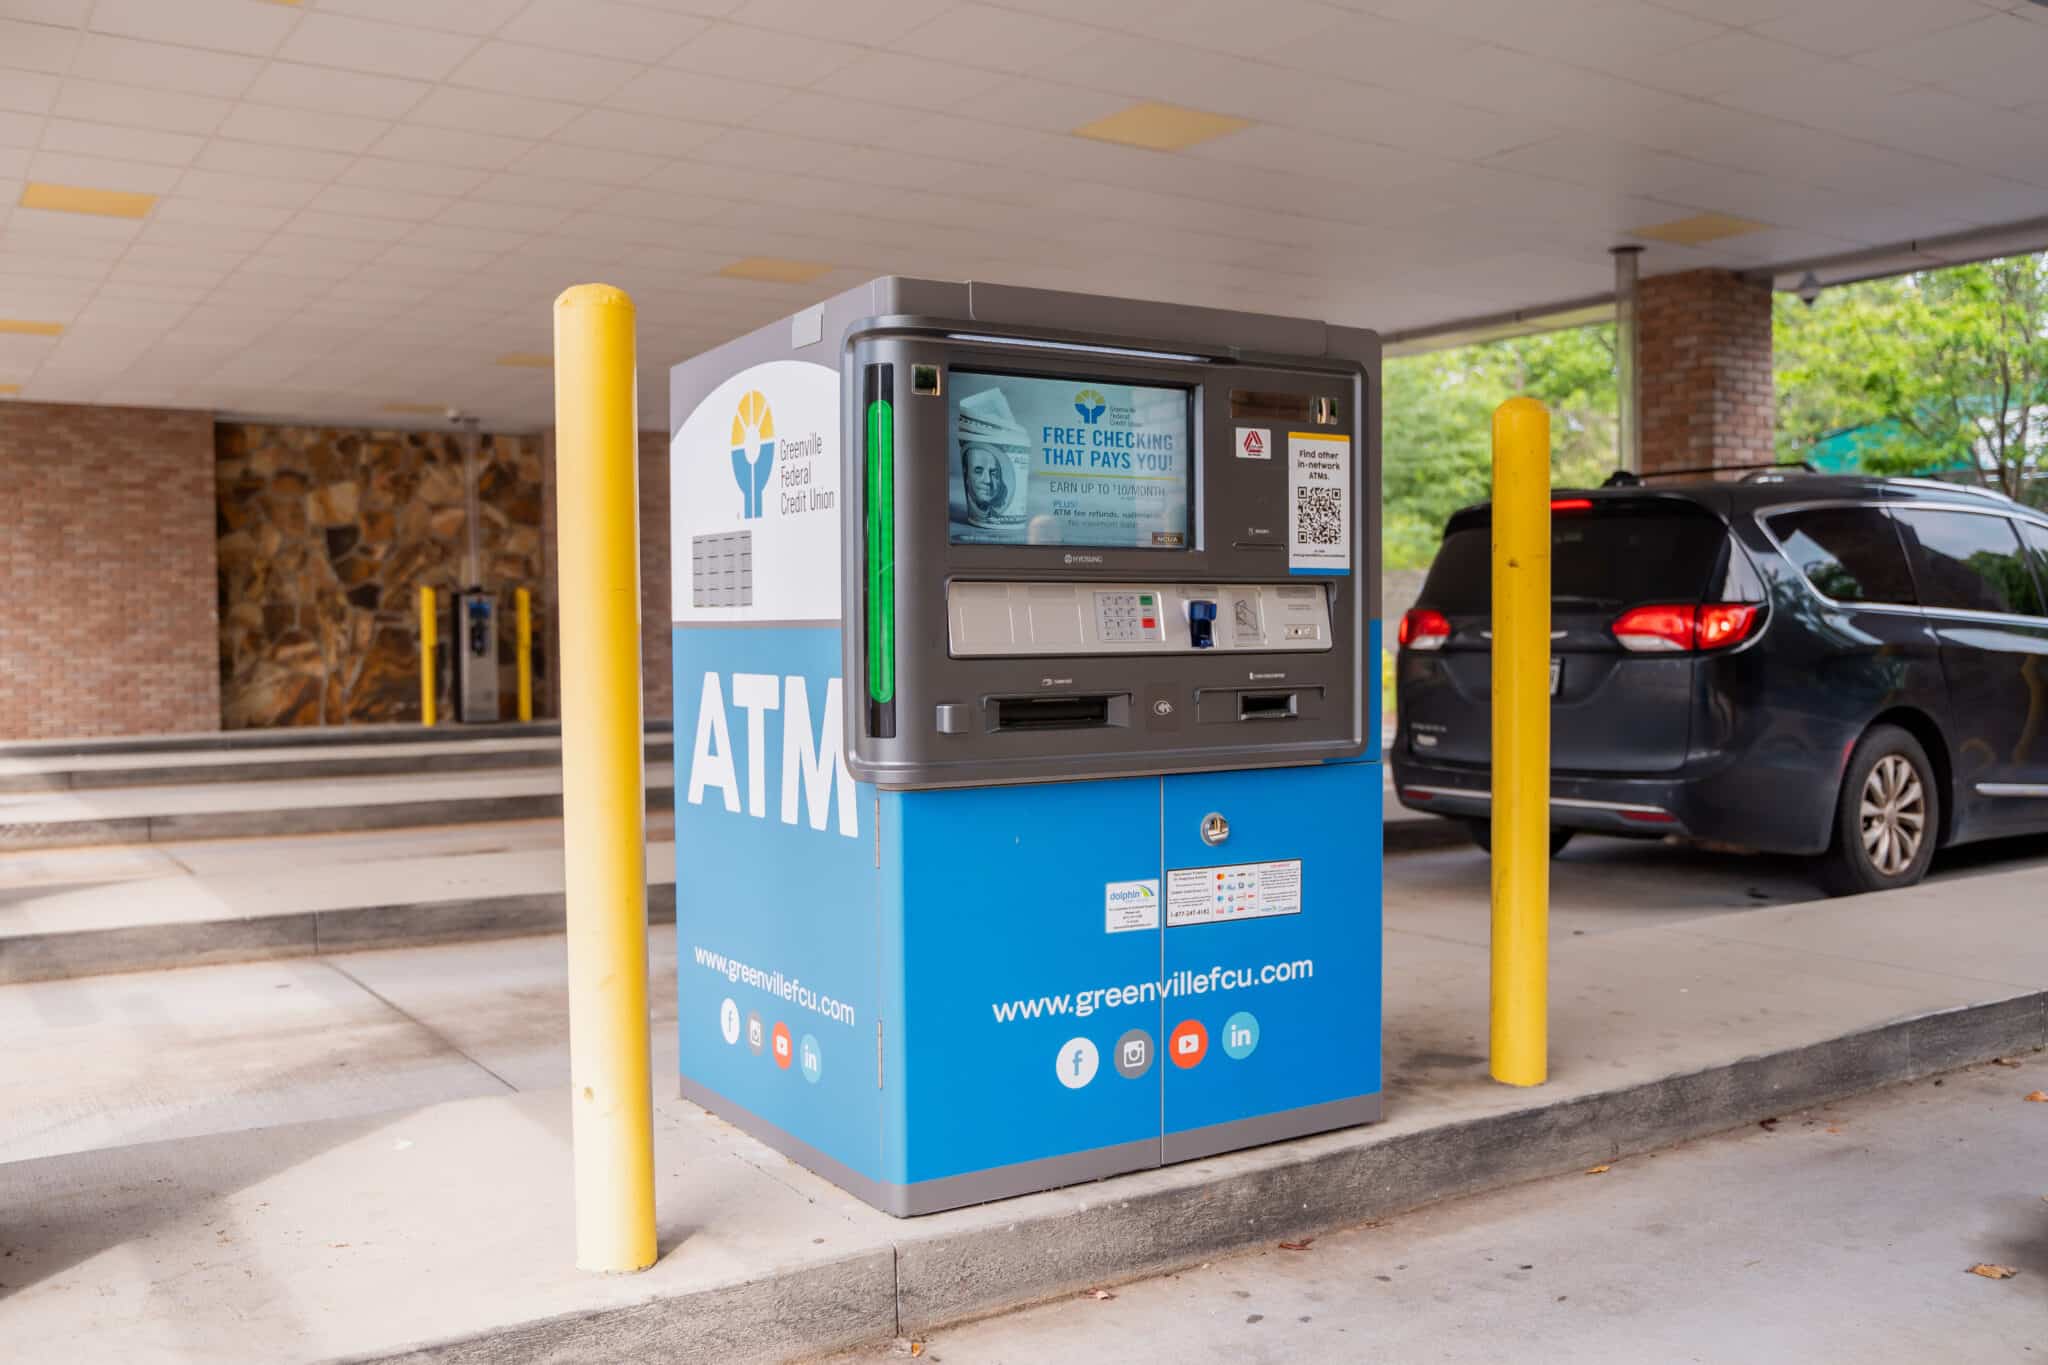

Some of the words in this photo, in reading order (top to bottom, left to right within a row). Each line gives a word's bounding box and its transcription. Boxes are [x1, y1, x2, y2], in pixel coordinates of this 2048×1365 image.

[780, 432, 822, 461] Greenville
[1043, 426, 1086, 445] FREE
[1092, 430, 1173, 450] CHECKING
[1042, 448, 1085, 466] THAT
[1090, 451, 1131, 469] PAYS
[1136, 454, 1173, 472] YOU!
[1298, 461, 1340, 470] in-network
[1299, 449, 1316, 459] Find
[1318, 451, 1339, 460] other
[780, 460, 811, 488] Federal
[1308, 472, 1330, 481] ATMs.
[1050, 481, 1077, 493] EARN
[1080, 483, 1094, 494] UP
[1097, 484, 1110, 495] TO
[780, 490, 806, 515] Credit
[810, 487, 834, 511] Union
[1053, 509, 1072, 517] ATM
[687, 671, 859, 838] ATM
[1110, 889, 1140, 902] dolphin
[694, 946, 856, 1027] www.greenvillefcu.com
[992, 959, 1314, 1024] www.greenvillefcu.com
